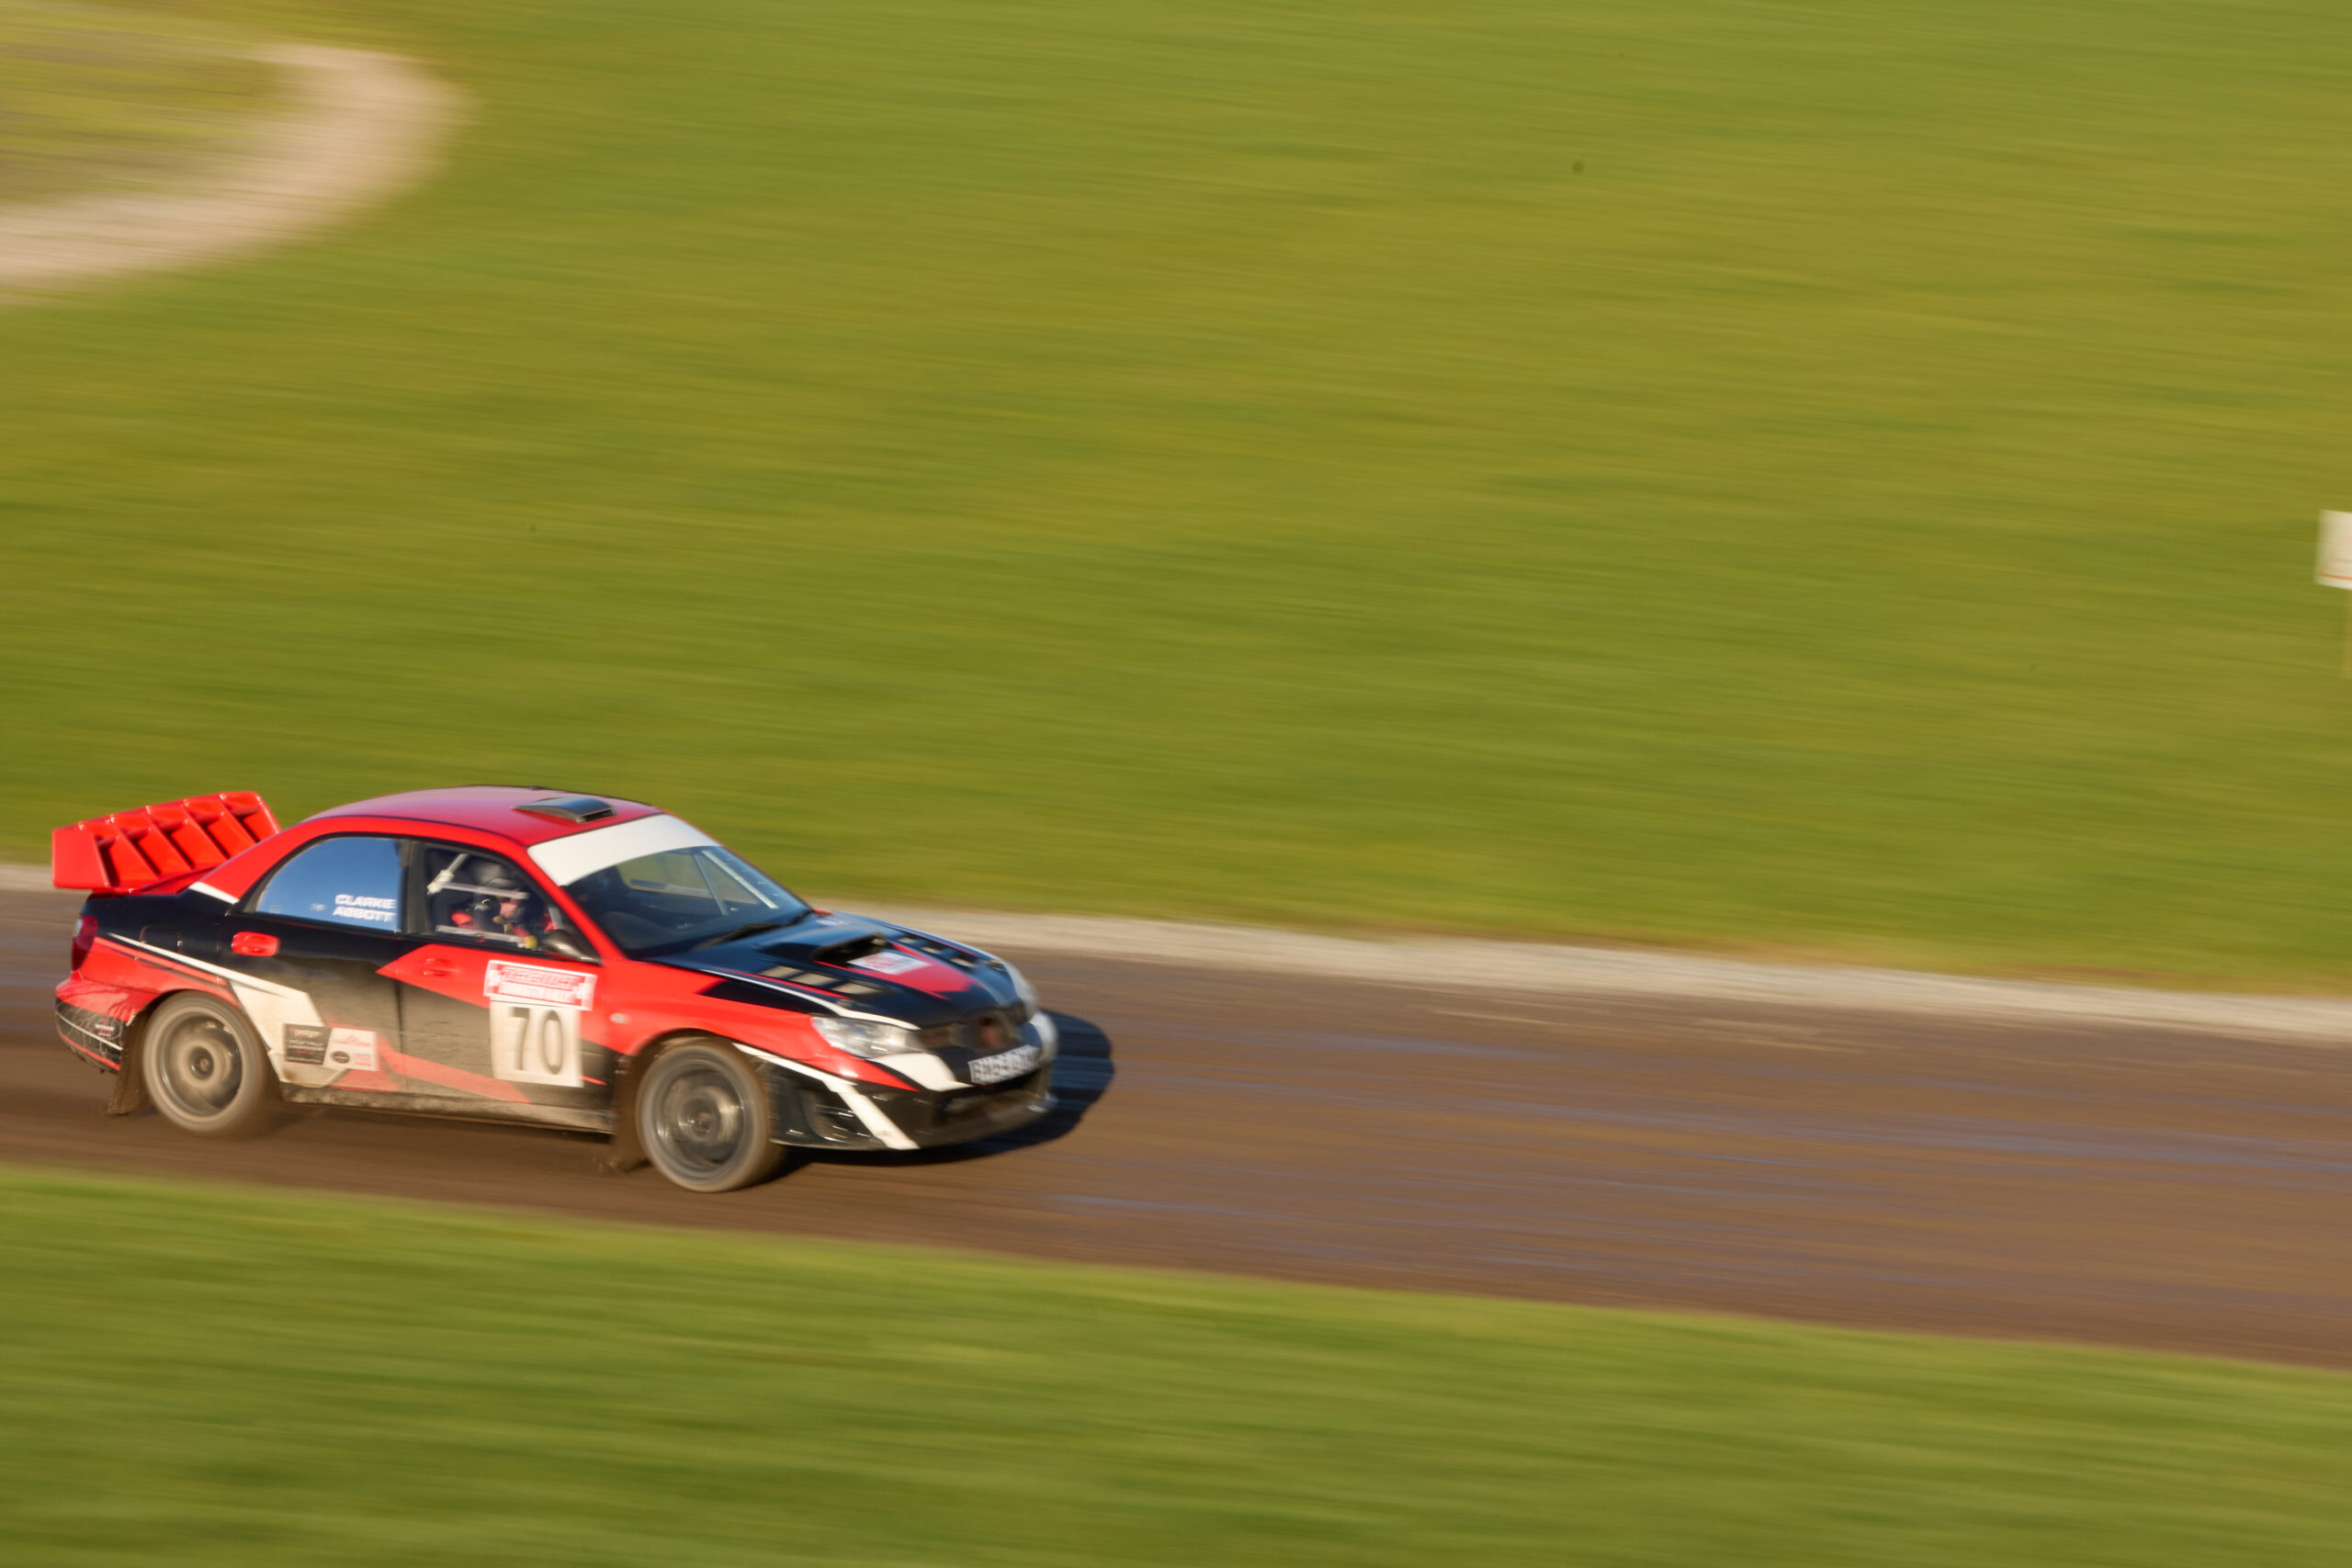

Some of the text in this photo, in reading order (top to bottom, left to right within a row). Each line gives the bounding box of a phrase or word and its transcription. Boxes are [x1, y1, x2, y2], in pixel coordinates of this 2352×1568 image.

[335, 894, 397, 909] CLARKE
[333, 906, 397, 922] ABBOTT
[509, 1007, 564, 1075] 70
